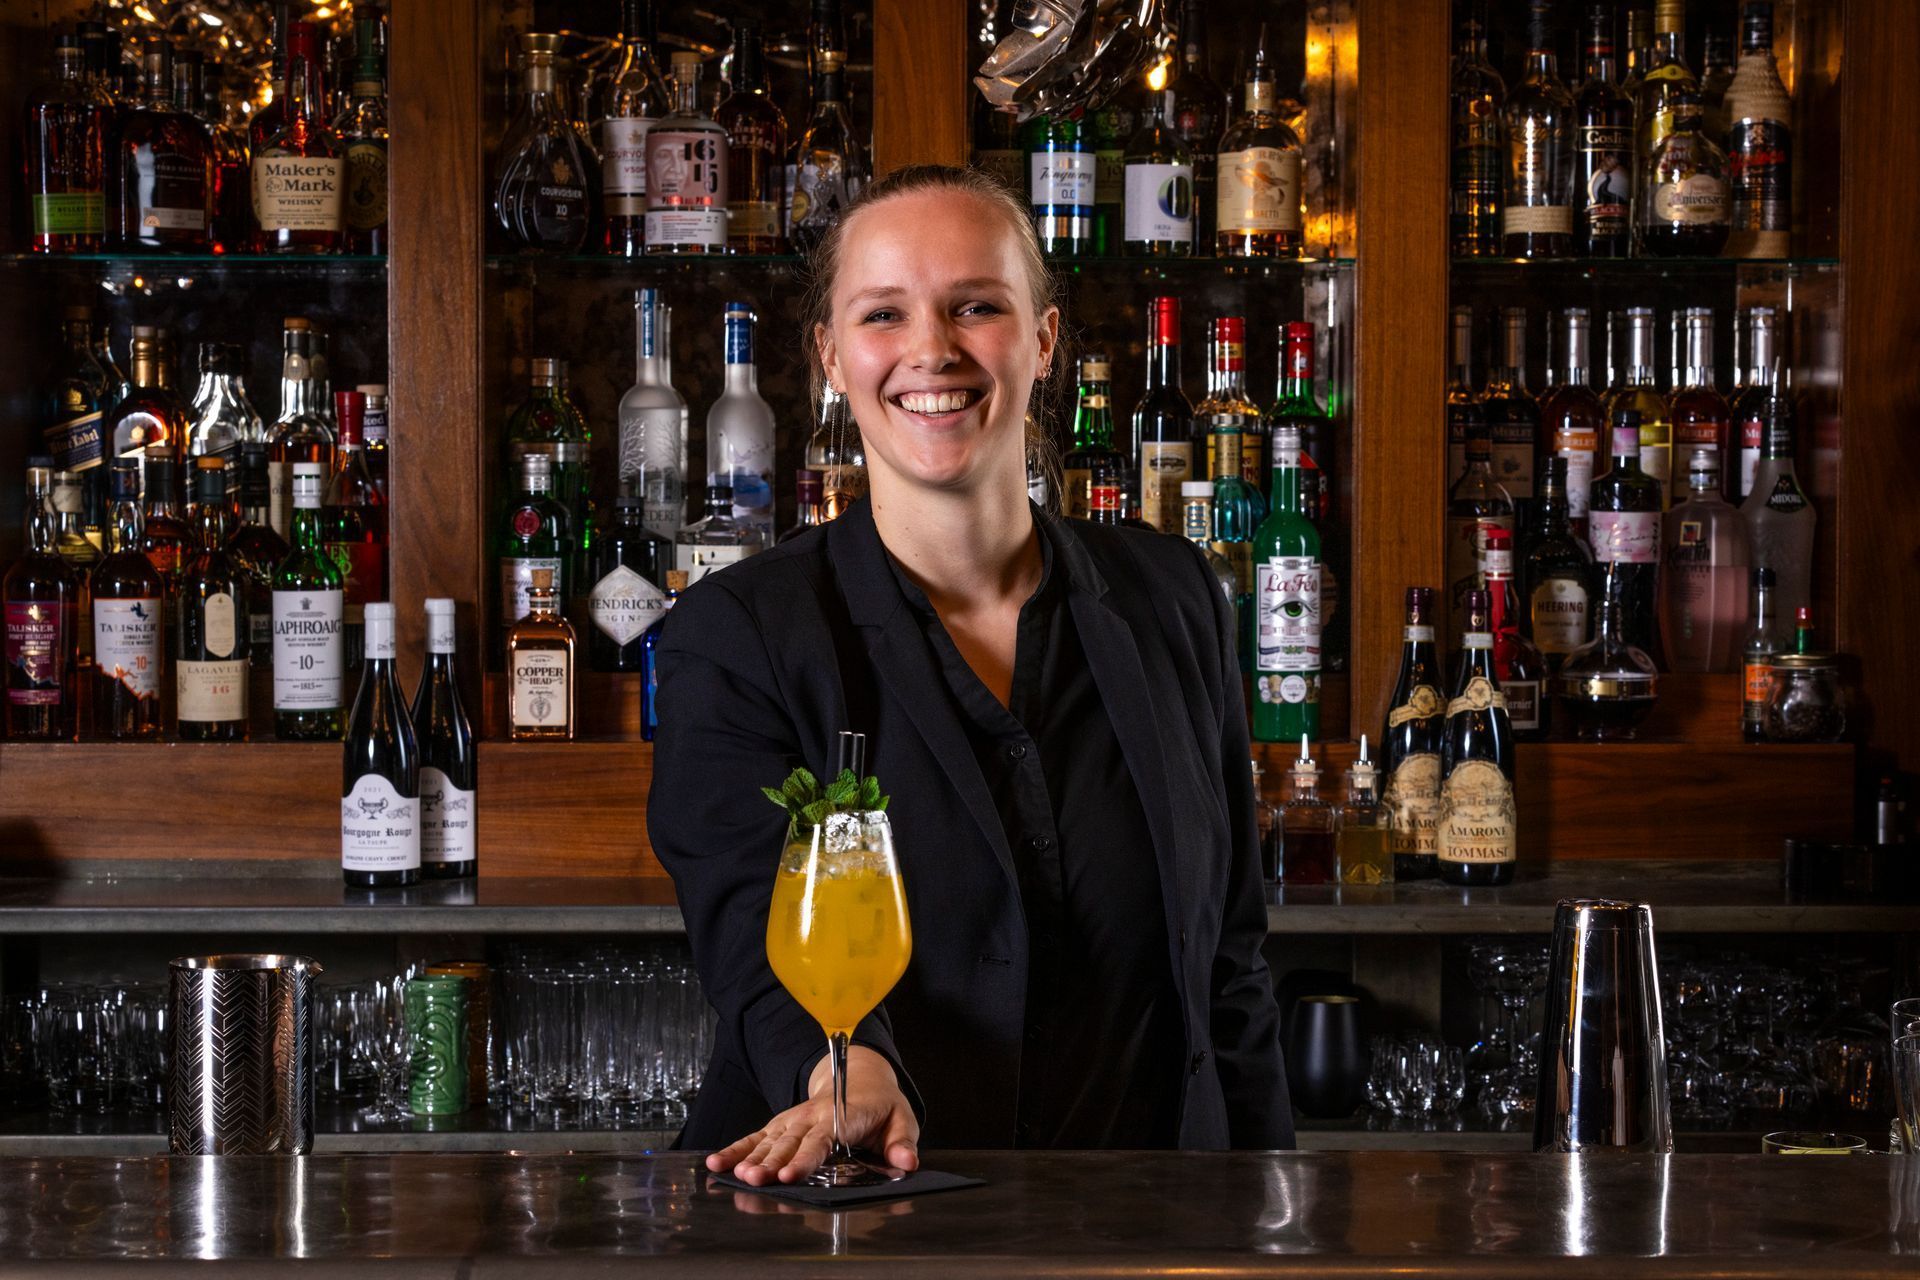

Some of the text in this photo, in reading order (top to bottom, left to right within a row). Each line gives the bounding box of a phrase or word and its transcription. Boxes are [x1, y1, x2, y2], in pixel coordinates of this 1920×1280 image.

[1586, 130, 1632, 145] Goslin
[265, 164, 336, 176] Maker's
[284, 179, 334, 192] Mark
[541, 187, 582, 199] COURVOISIER
[277, 198, 324, 206] WHISKY
[555, 203, 568, 216] XO
[364, 414, 384, 427] ked
[71, 427, 100, 448] Label
[1265, 573, 1288, 593] La
[591, 598, 664, 610] HENDRICK'S
[1537, 601, 1583, 613] HEERING
[7, 623, 54, 633] TALISKER
[275, 620, 340, 635] LAPHROAIG
[136, 656, 147, 670] 10
[299, 655, 313, 669] 10
[517, 667, 564, 677] COPPER
[529, 677, 552, 685] HEAD
[212, 685, 229, 694] 16
[342, 827, 412, 838] Bourgogne Rouge
[1446, 846, 1509, 859] TOMMASI
